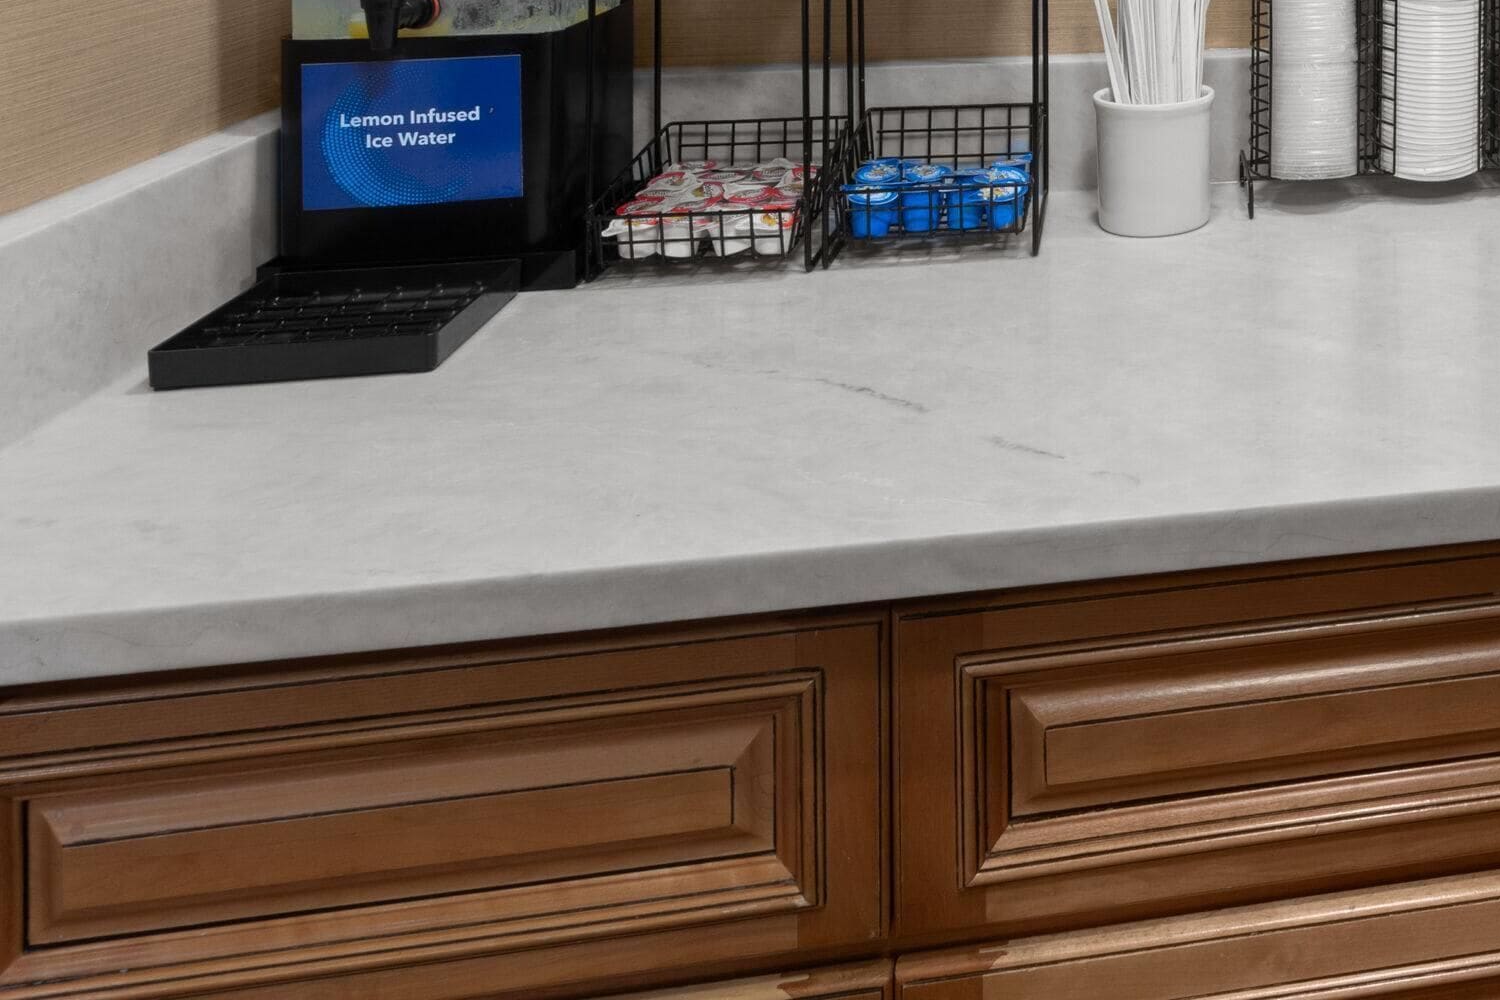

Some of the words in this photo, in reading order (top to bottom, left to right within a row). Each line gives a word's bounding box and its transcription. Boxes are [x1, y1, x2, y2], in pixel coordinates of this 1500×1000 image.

[340, 113, 404, 128] Lemon
[410, 105, 480, 124] Infused
[366, 134, 393, 148] Ice
[397, 131, 456, 147] Water
